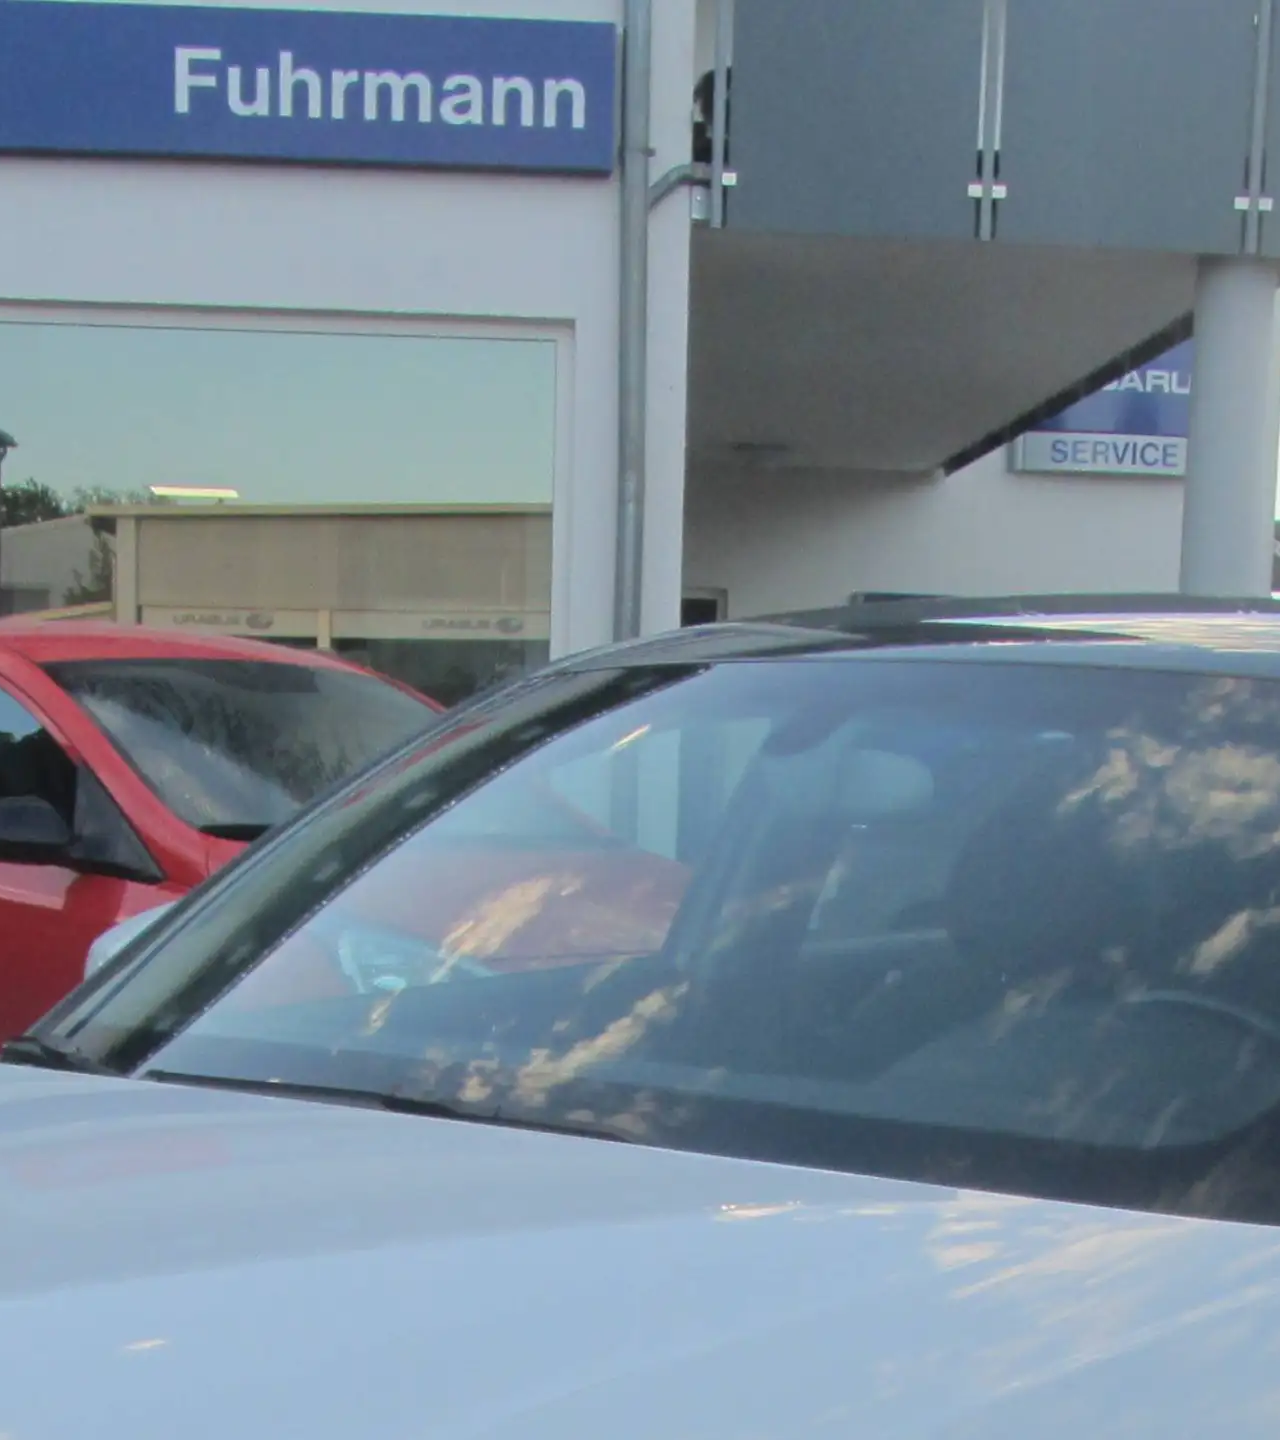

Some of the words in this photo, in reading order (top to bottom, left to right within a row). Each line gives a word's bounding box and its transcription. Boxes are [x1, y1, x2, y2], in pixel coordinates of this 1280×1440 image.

[174, 46, 586, 129] Fuhrmann
[1102, 369, 1191, 394] ARU
[1051, 440, 1179, 468] SERVICE
